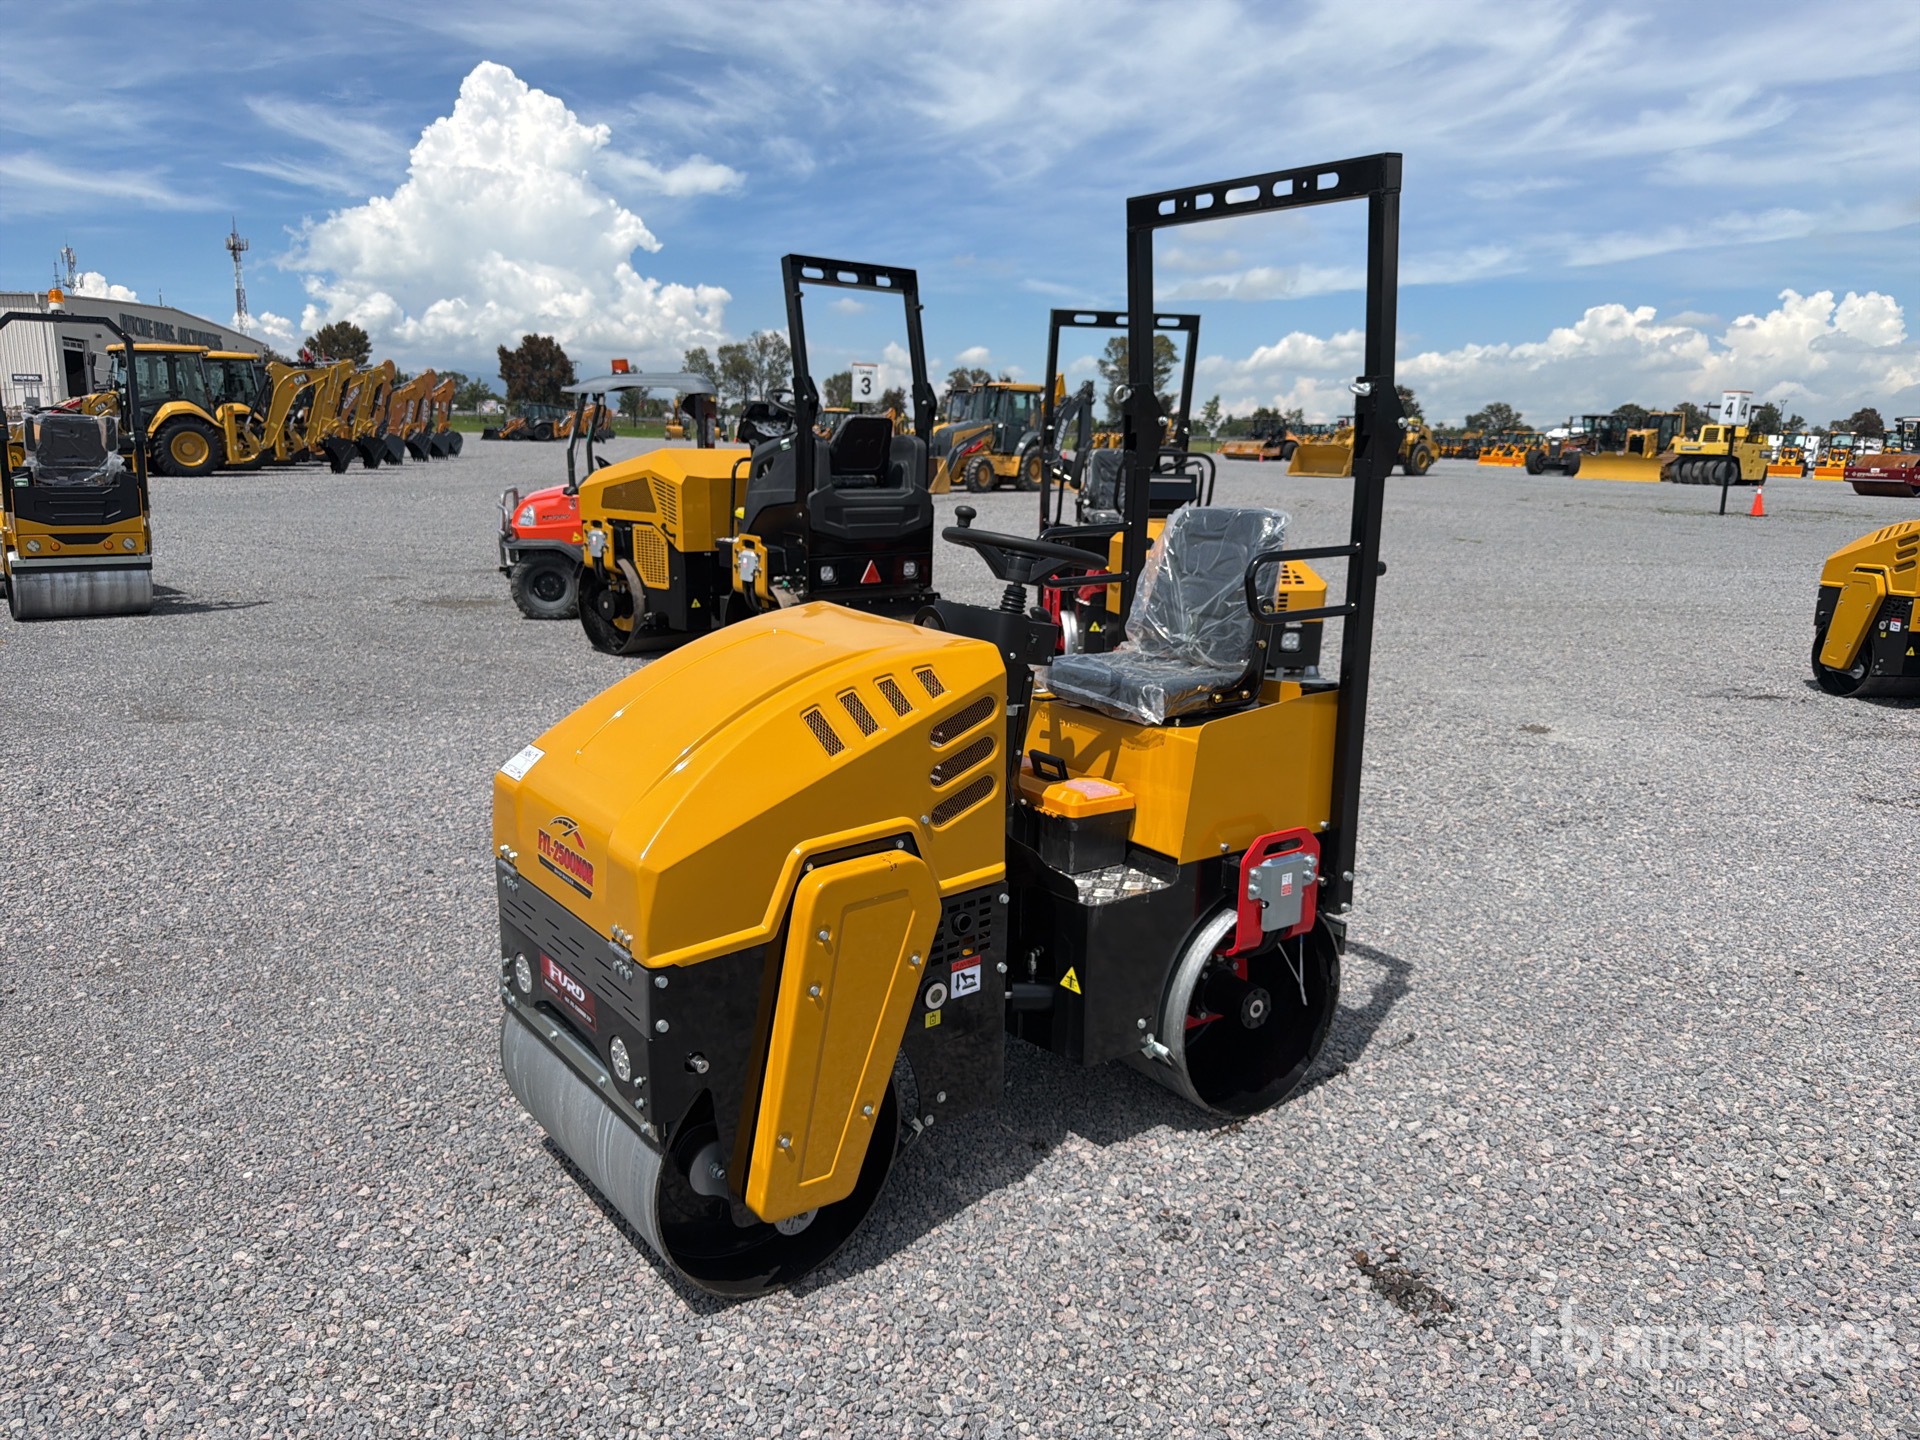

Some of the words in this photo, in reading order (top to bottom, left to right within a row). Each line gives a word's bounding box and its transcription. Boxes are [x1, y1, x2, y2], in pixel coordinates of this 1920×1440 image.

[293, 373, 308, 386] CAT
[861, 377, 872, 396] 3
[342, 386, 360, 409] CASE
[1724, 402, 1734, 419] 4
[1740, 403, 1748, 419] 4
